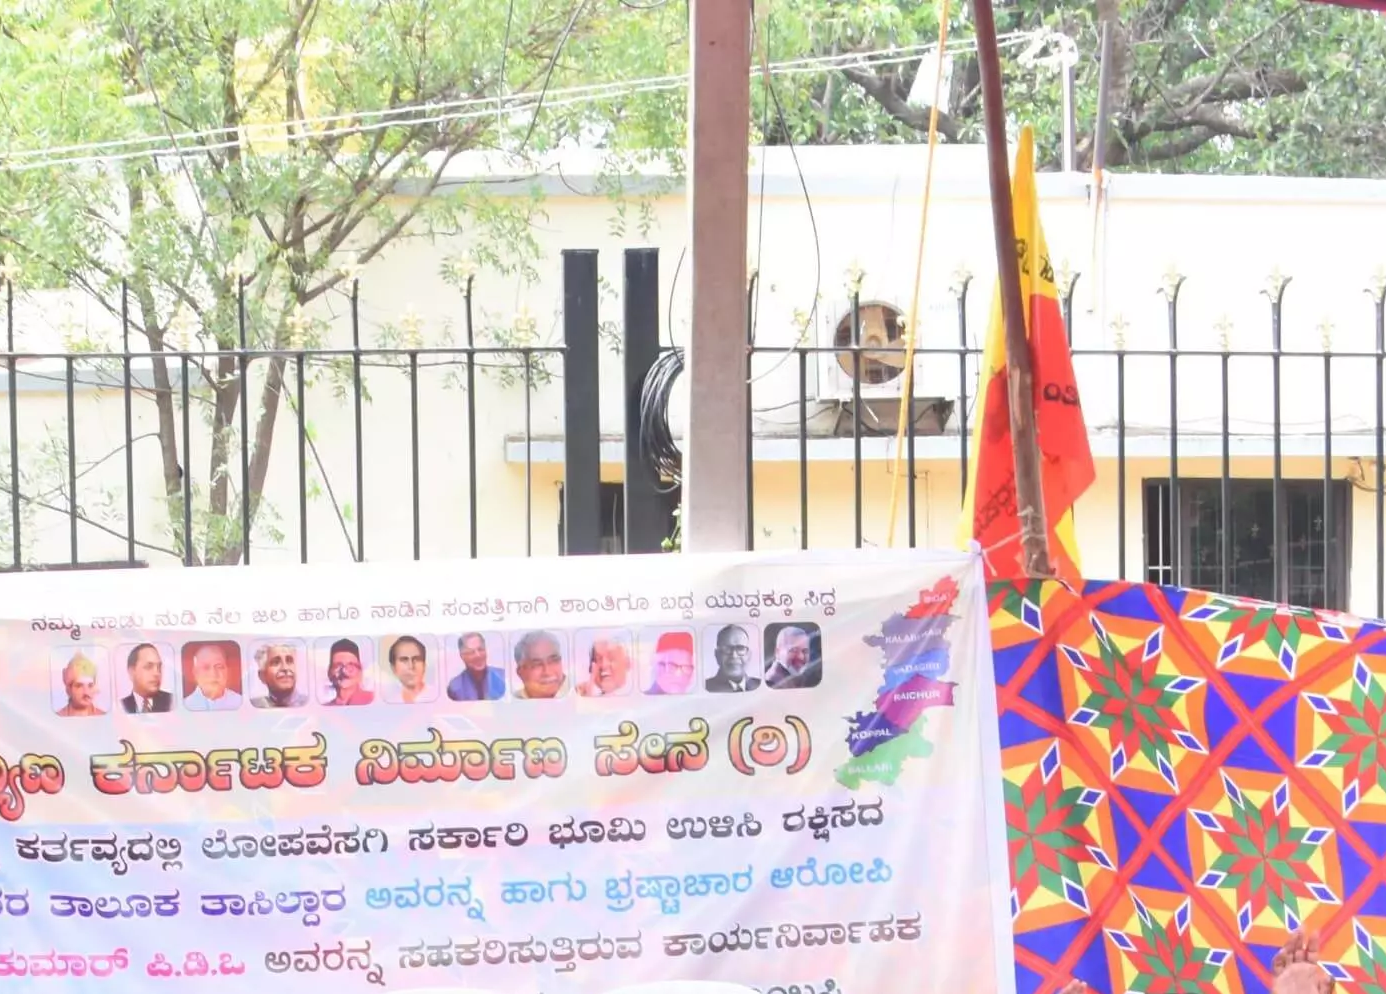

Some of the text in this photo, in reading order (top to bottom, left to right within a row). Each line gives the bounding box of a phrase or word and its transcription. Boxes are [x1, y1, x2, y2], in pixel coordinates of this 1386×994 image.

[31, 616, 81, 640] ನಮ್ಮ
[298, 601, 361, 620] ಹಾಗೂ
[371, 599, 431, 619] ನಾಡಿನ
[893, 690, 941, 702] RAICHUR
[89, 732, 328, 795] ಕರ್ನಾಟಕ
[355, 727, 568, 786] ನಿರ್ಮಾಣ
[593, 717, 710, 777] ಸೇನೆ
[726, 715, 812, 776] (ರಿ)
[15, 831, 184, 876] ಕರ್ತವ್ಯದಲ್ಲಿ
[201, 824, 390, 860] ಲೋಪವೆಸಗಿ
[408, 819, 529, 852] ಸರ್ಕಾರಿ
[548, 815, 647, 850] ಭೂಮಿ
[665, 810, 763, 840] ಉಳಿಸಿ
[49, 889, 181, 918] ತಾಲೂಕ
[365, 876, 487, 922] ಅವರನ್ನ
[500, 873, 588, 905] ಹಾಗು
[264, 940, 386, 986] ಅವರನ್ನ
